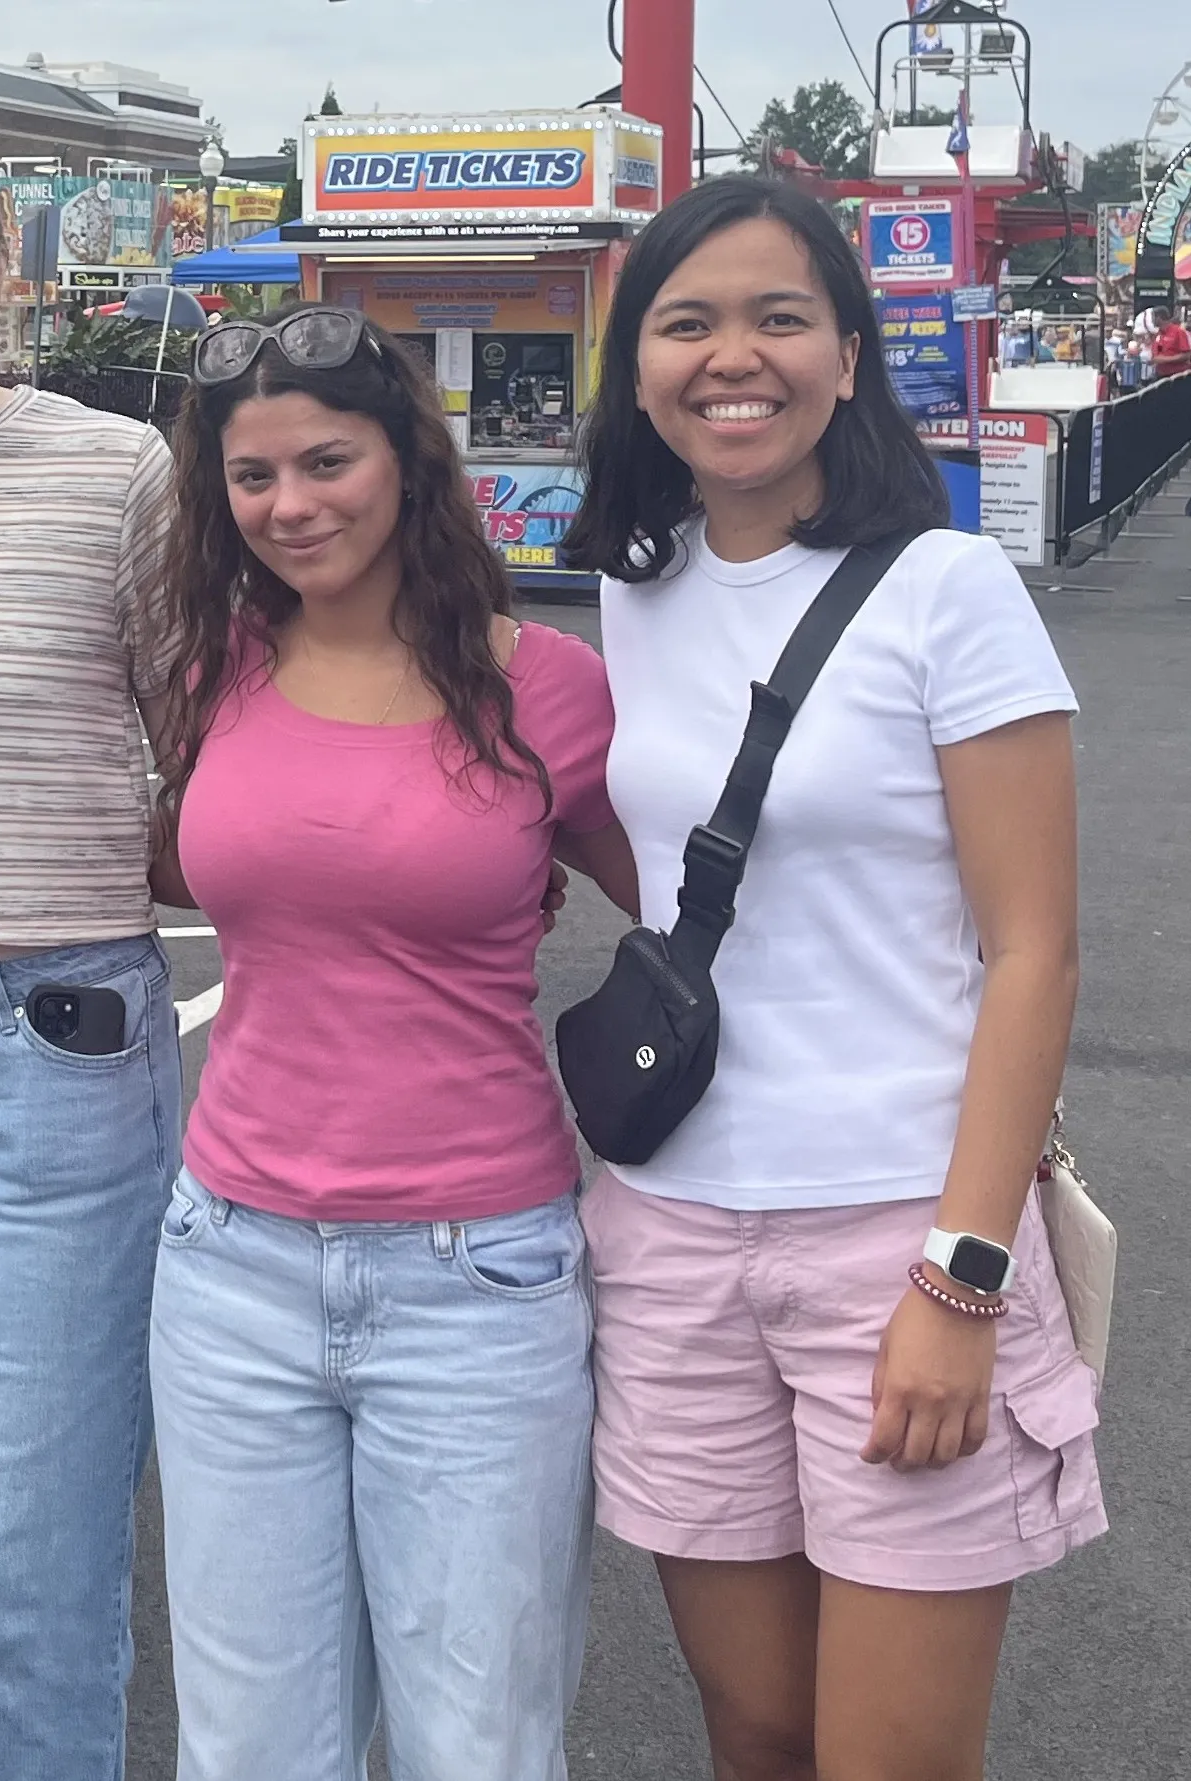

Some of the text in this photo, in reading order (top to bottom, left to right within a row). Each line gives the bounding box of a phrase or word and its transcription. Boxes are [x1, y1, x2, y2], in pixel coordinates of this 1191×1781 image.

[326, 151, 580, 189] RIDE TICKETS
[11, 183, 55, 199] FUNNEL
[874, 204, 893, 212] THIS
[896, 203, 915, 211] RIDE
[318, 227, 345, 237] Share
[347, 229, 369, 238] your
[371, 227, 422, 238] experience
[424, 226, 446, 236] with
[447, 227, 459, 235] us
[460, 226, 474, 235] at:
[896, 221, 923, 246] 15
[887, 252, 936, 265] TICKETS
[506, 548, 554, 564] HERE
